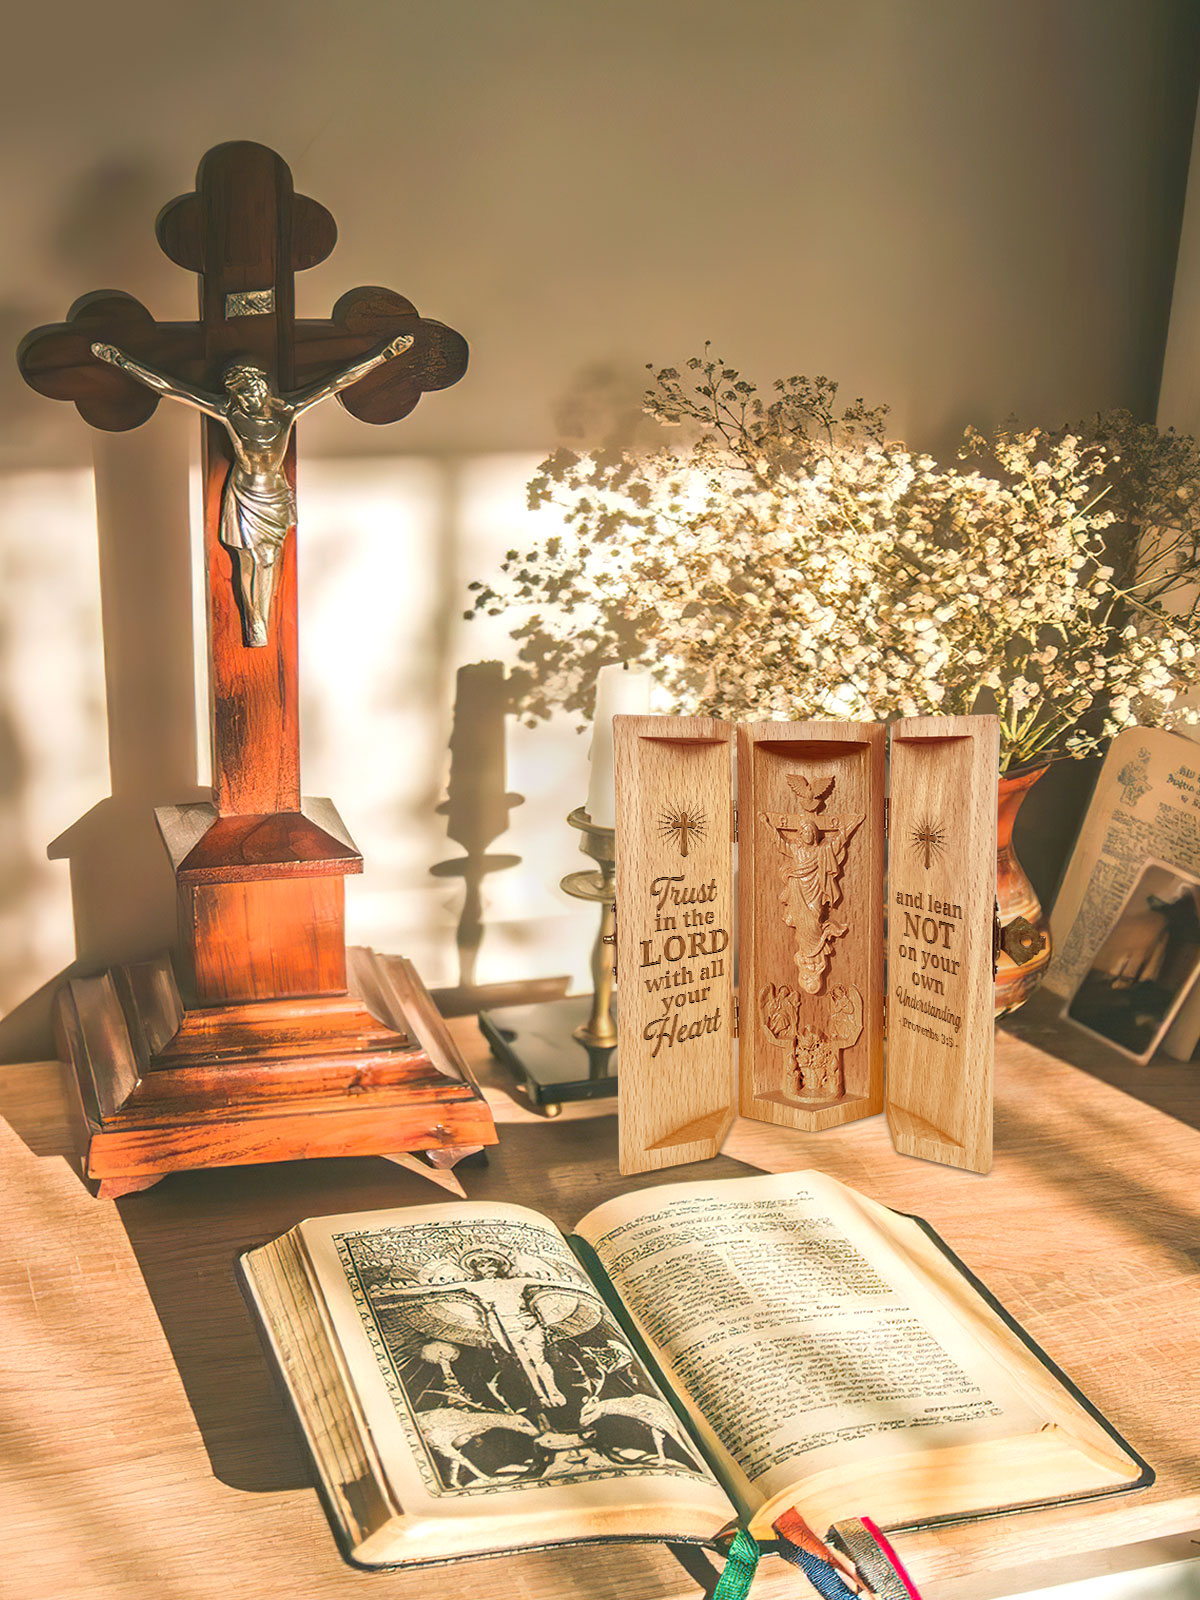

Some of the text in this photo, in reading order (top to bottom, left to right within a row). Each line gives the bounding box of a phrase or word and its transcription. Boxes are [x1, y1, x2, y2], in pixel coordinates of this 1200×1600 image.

[649, 874, 718, 911] Trust
[896, 891, 963, 920] and lean
[654, 908, 715, 932] in the
[904, 911, 956, 950] NOT
[640, 928, 729, 968] LORD
[898, 944, 961, 976] on your
[644, 958, 724, 993] with all
[911, 971, 945, 996] own
[661, 986, 711, 1018] your
[895, 985, 962, 1034] Understanding
[643, 1007, 722, 1058] Heart
[902, 1016, 940, 1042] Proverbs
